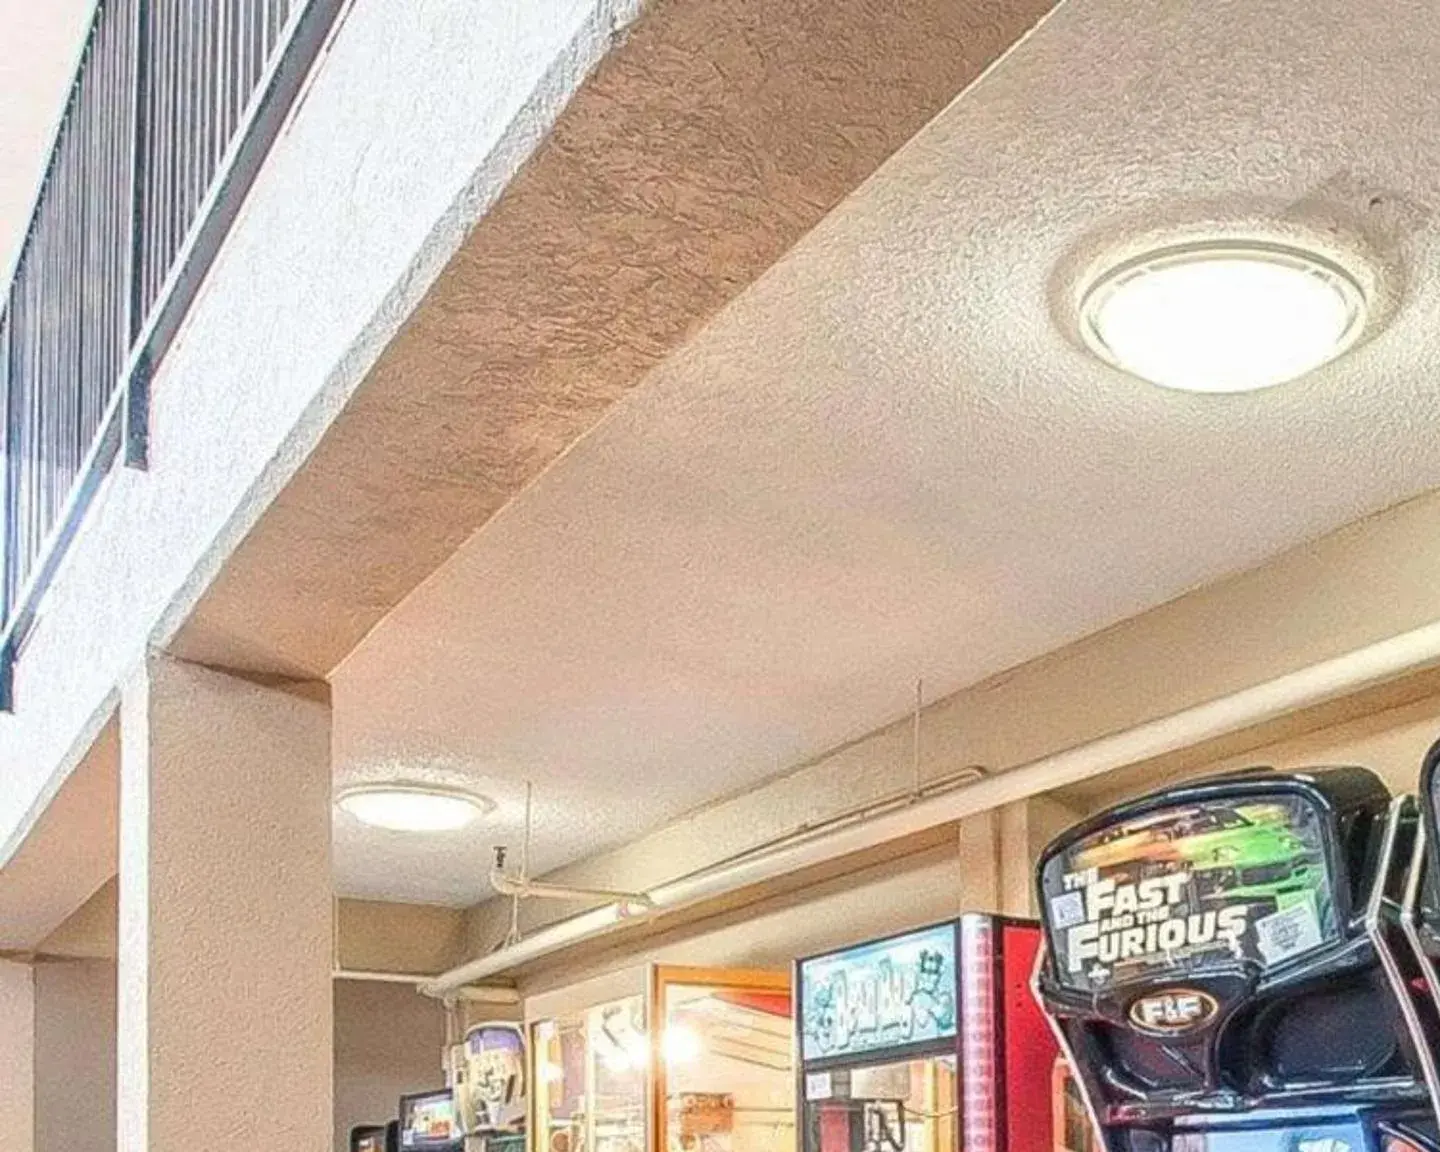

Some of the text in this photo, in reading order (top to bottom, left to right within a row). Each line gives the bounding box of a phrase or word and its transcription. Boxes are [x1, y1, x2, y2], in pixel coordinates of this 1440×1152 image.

[1085, 872, 1191, 922] FAST
[1101, 913, 1134, 931] AND
[1068, 904, 1249, 973] FURIOUS
